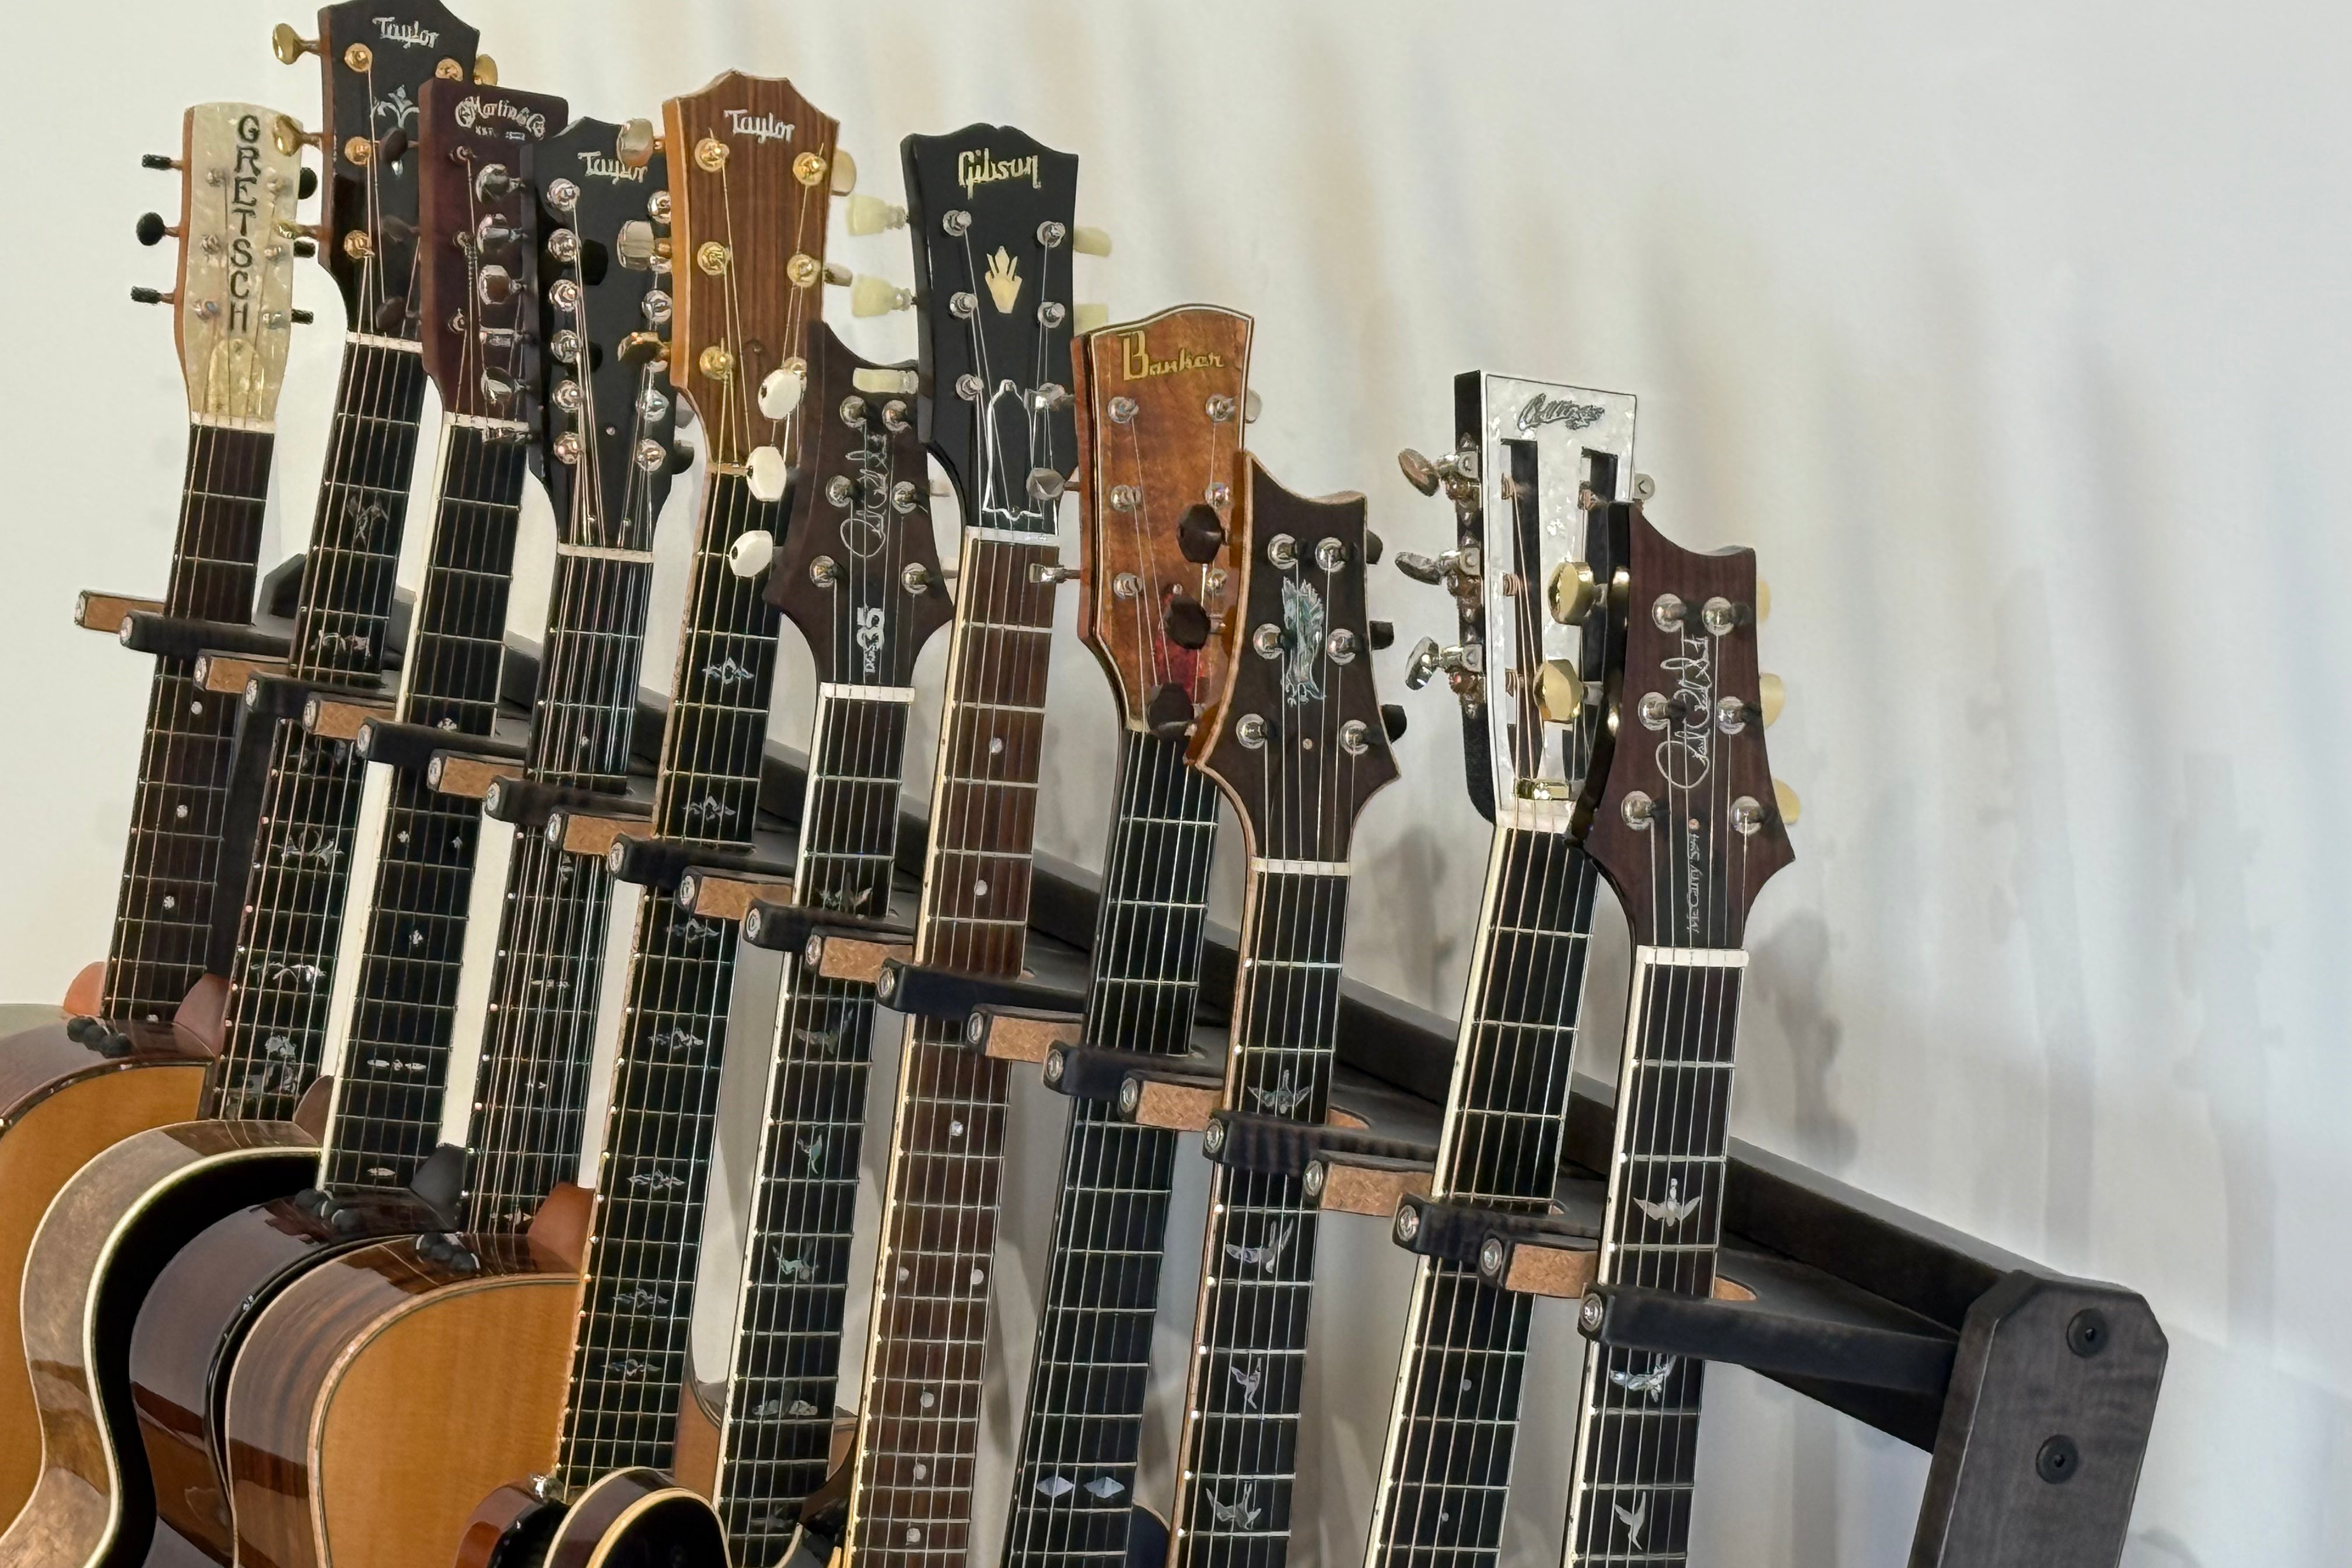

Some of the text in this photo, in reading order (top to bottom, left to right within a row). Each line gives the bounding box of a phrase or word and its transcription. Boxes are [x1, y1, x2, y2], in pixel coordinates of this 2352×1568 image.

[372, 16, 439, 49] Taylor
[724, 109, 795, 144] Taylor
[958, 147, 1042, 200] Gibson
[230, 114, 261, 334] GRETSCH
[1118, 330, 1225, 382] Banker
